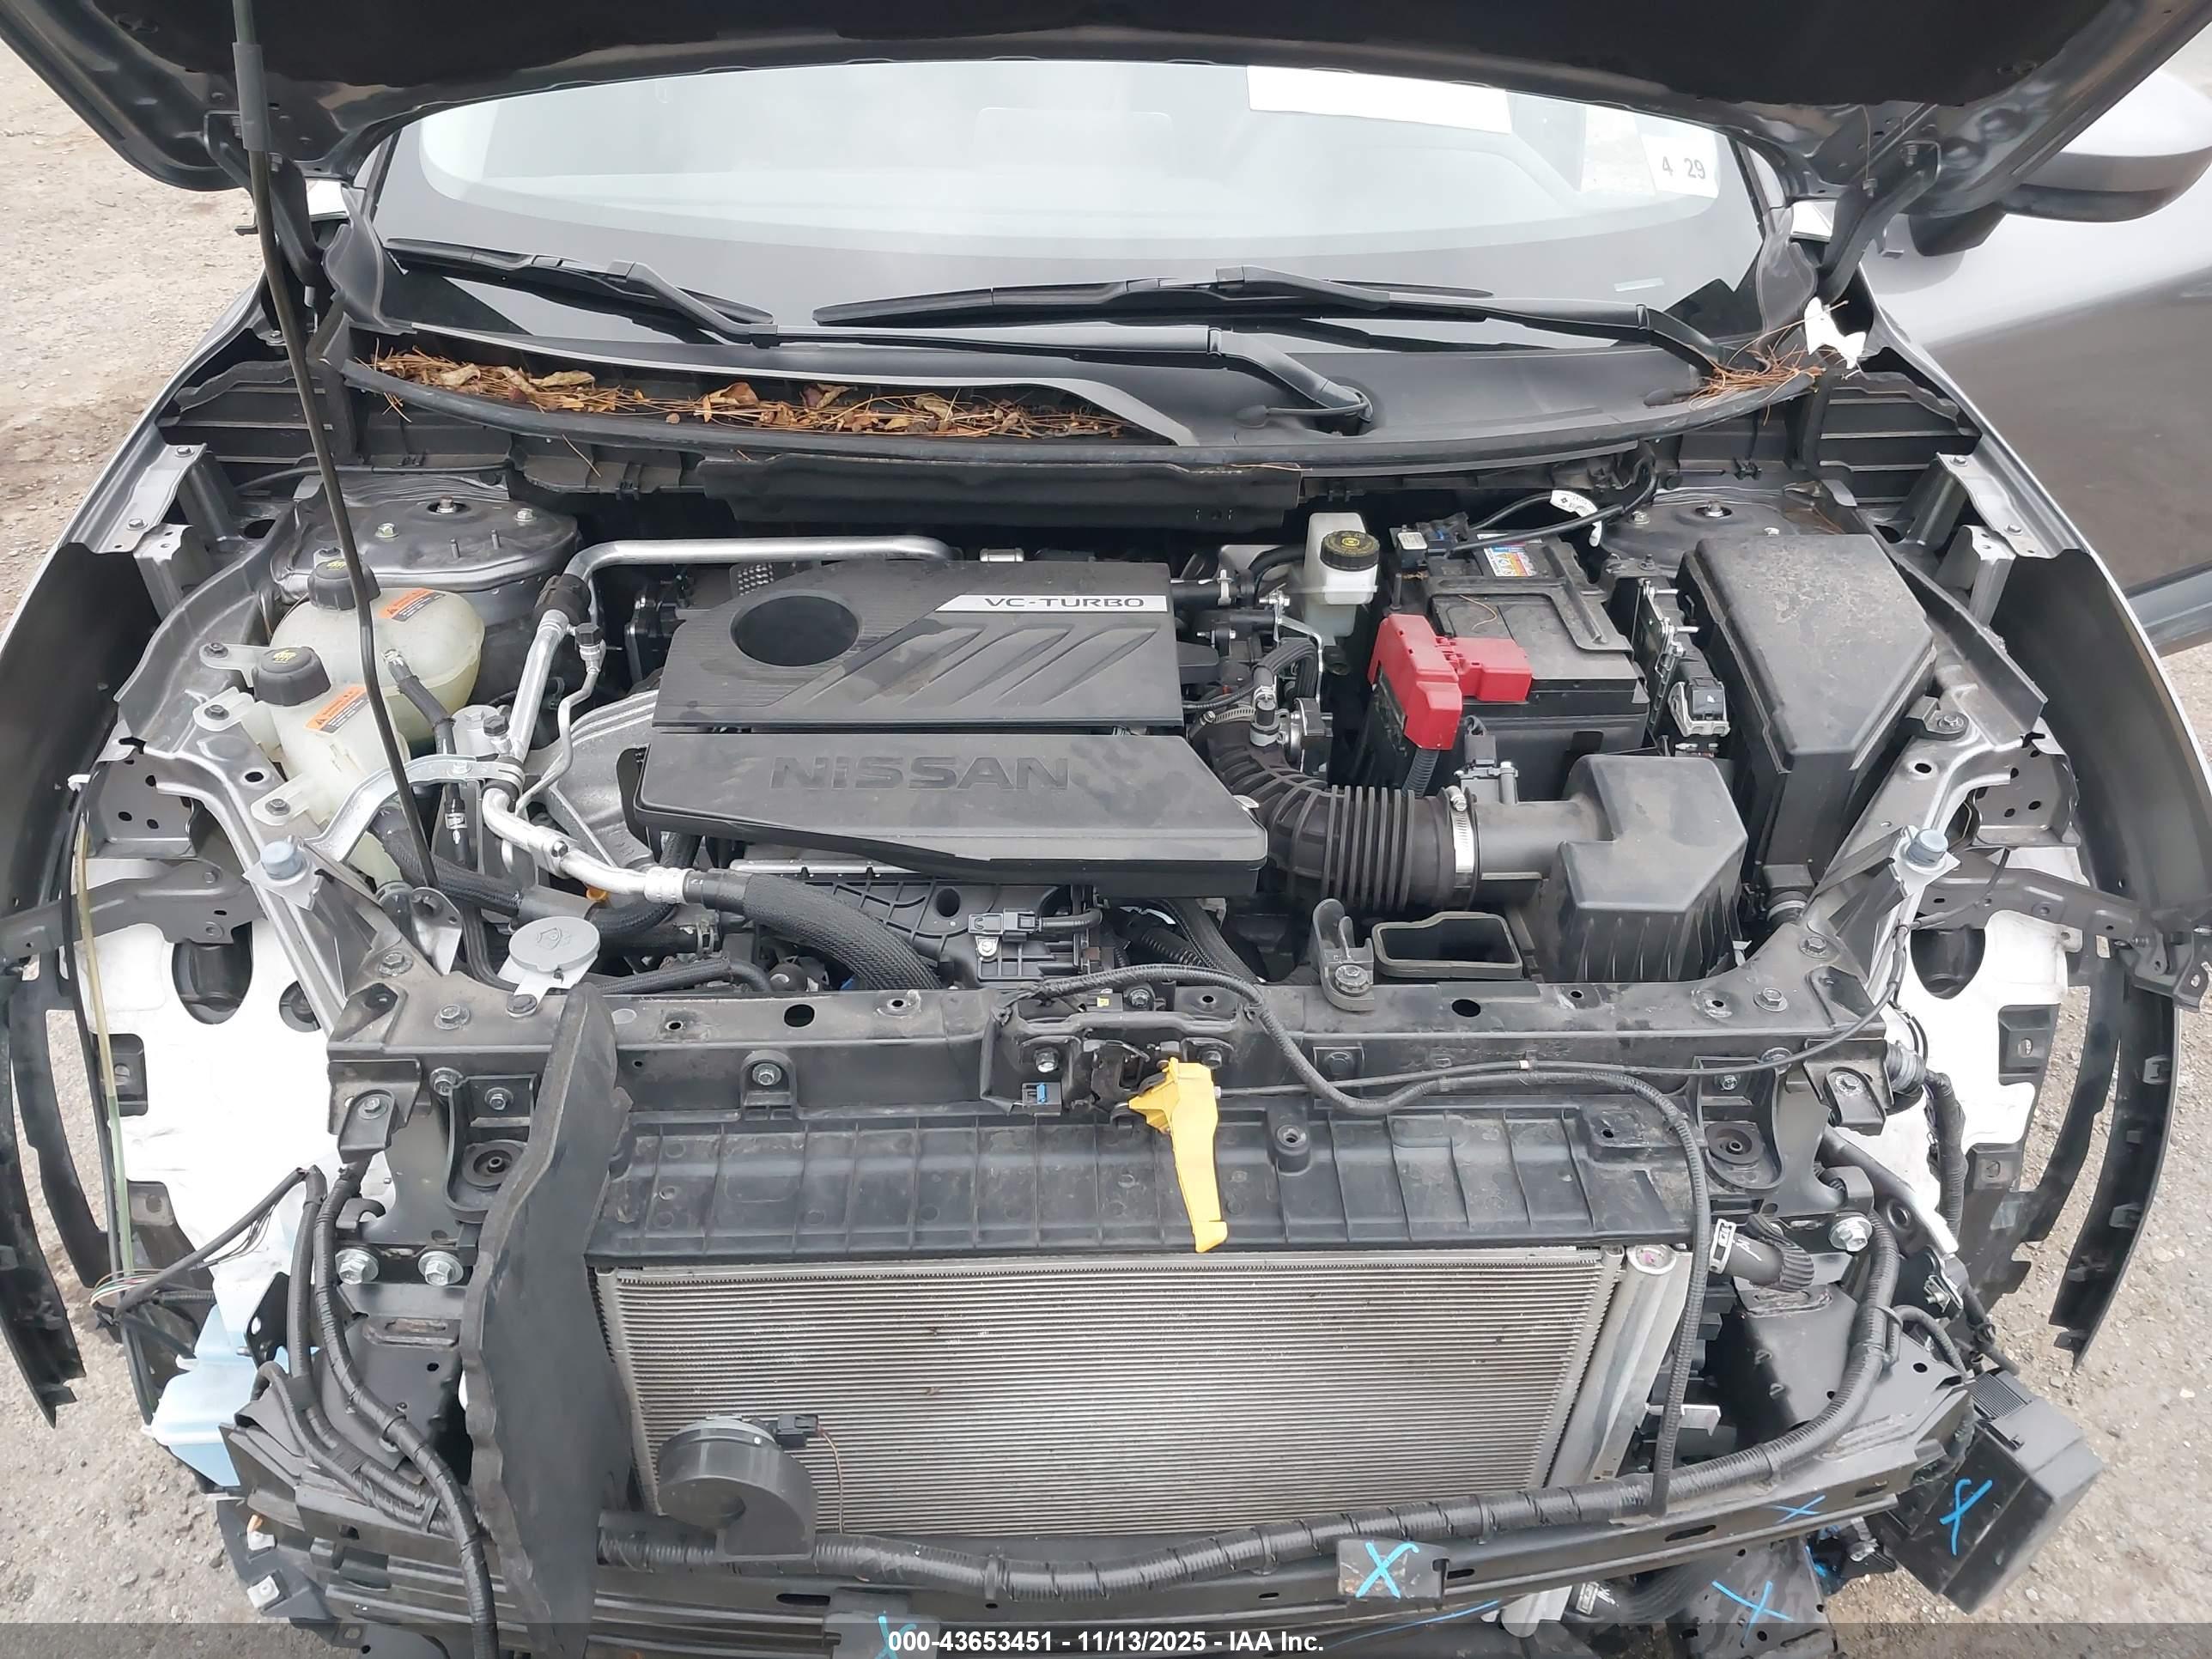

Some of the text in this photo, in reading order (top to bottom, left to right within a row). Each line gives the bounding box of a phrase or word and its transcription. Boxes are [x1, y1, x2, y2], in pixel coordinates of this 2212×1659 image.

[1662, 156, 1706, 179] 4 29
[984, 598, 1145, 607] VC-TURBO
[770, 756, 1069, 790] NISSAN
